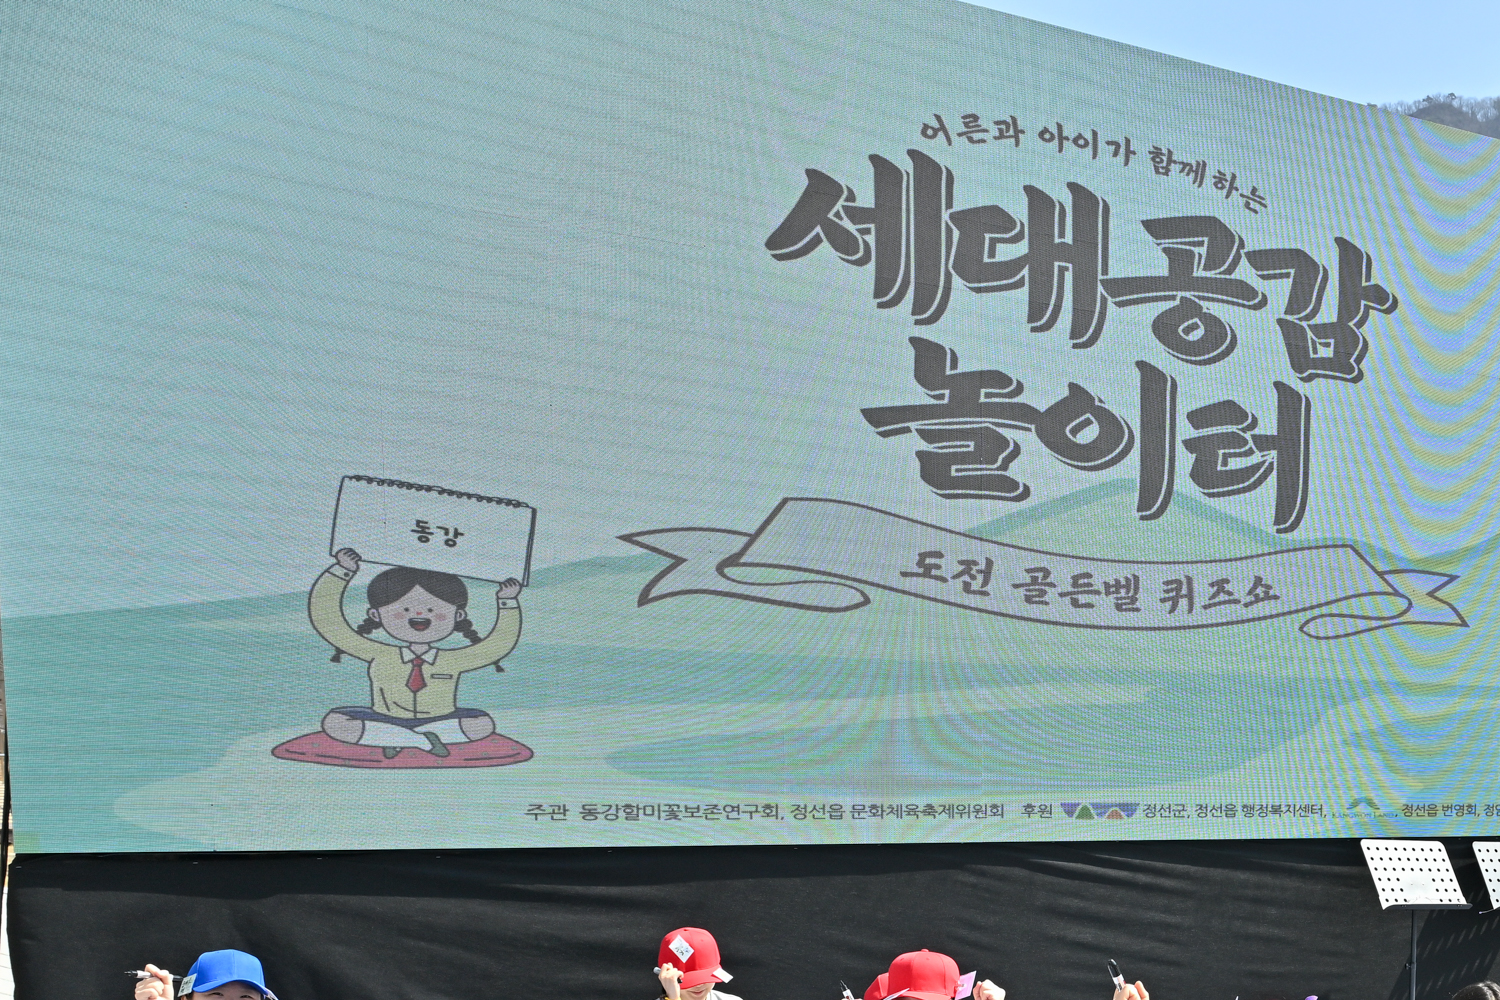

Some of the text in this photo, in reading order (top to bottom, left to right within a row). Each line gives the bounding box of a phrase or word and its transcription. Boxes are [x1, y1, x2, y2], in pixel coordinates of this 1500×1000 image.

[919, 113, 1026, 147] 어른과
[1037, 122, 1137, 167] 아이가
[860, 336, 1311, 534] 놀이터
[410, 519, 465, 548] 동강
[899, 549, 1281, 614] 도전 골든벨 퀴즈쇼
[524, 803, 1005, 821] 주관 동강할미꽃보존연구회, 정선읍 문화체육축제위원회
[1020, 802, 1328, 819] 후원 정선군, 정선읍 행정복지센터,
[1401, 803, 1439, 817] 정선읍
